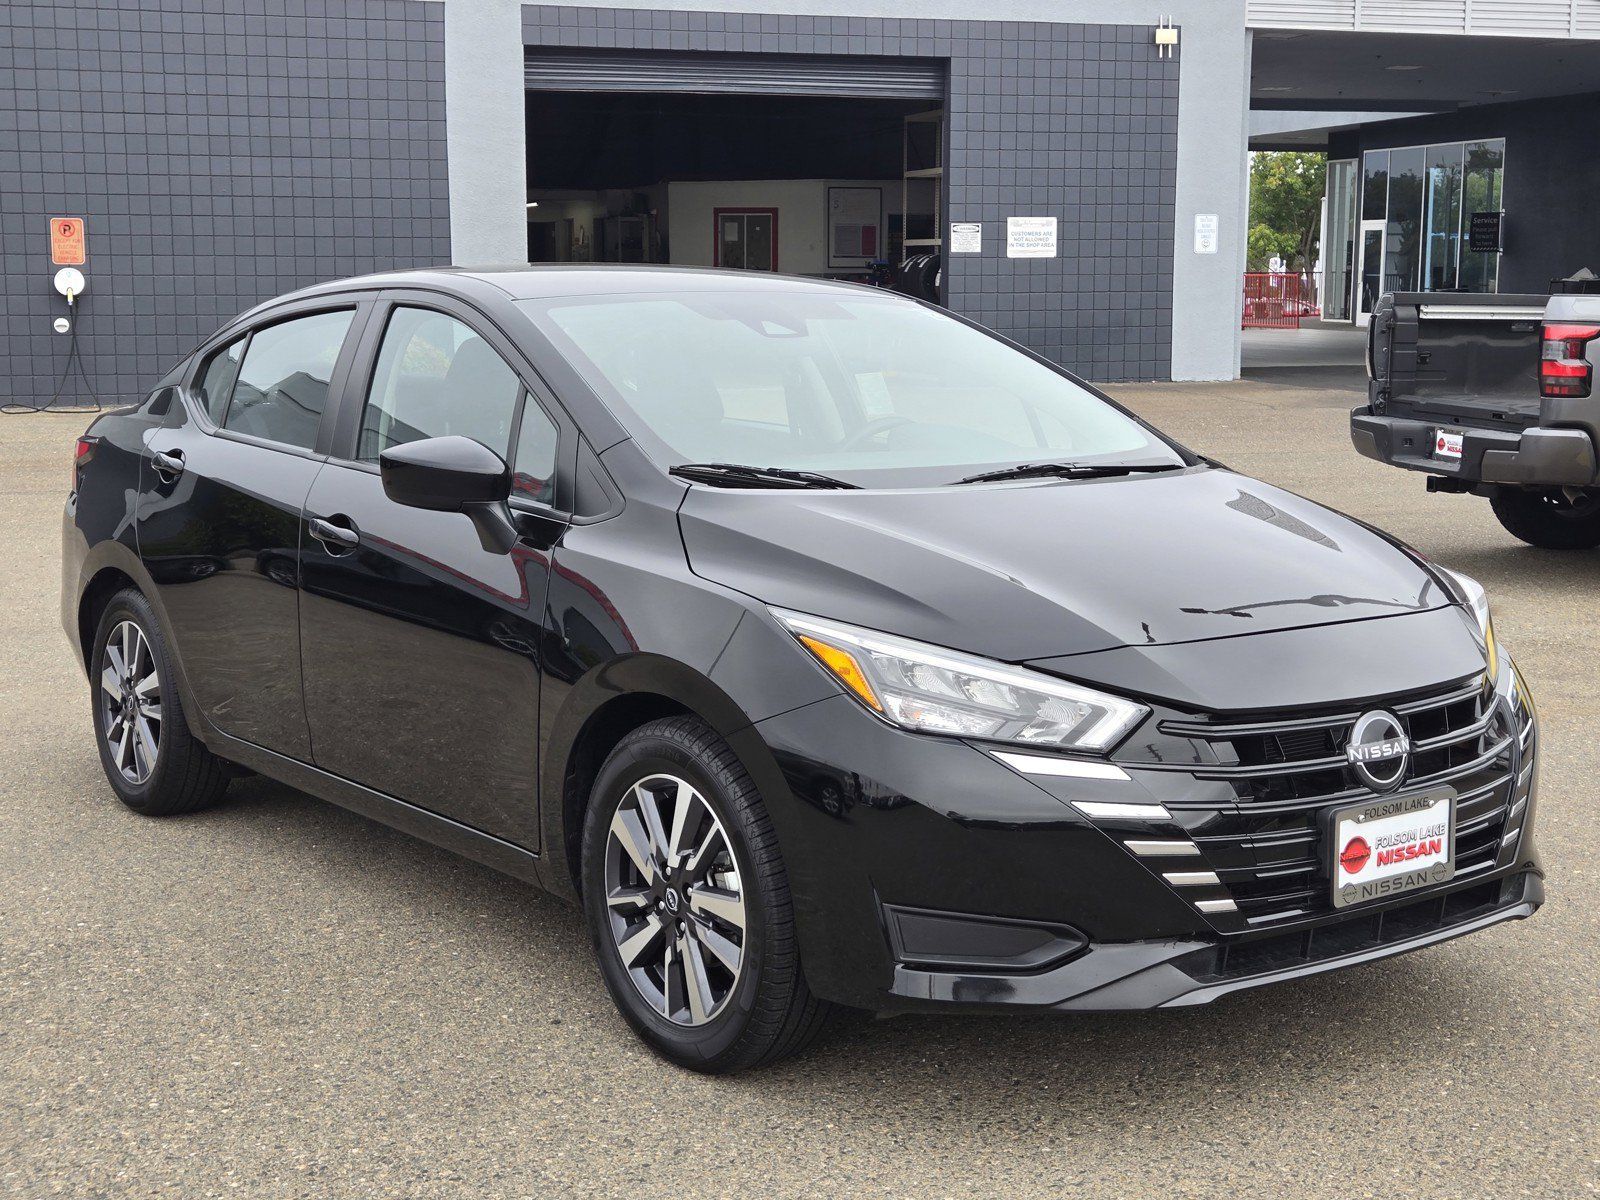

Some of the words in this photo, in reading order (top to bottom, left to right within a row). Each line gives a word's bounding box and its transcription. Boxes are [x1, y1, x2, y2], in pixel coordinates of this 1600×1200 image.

[1350, 740, 1410, 761] NISSAN
[1364, 802, 1402, 819] FOLSOM
[1404, 796, 1429, 811] LAKE
[1374, 828, 1418, 849] FOLSOM
[1419, 823, 1446, 840] LAKE
[1376, 838, 1442, 867] NISSAN
[1362, 871, 1428, 898] NISSAN
